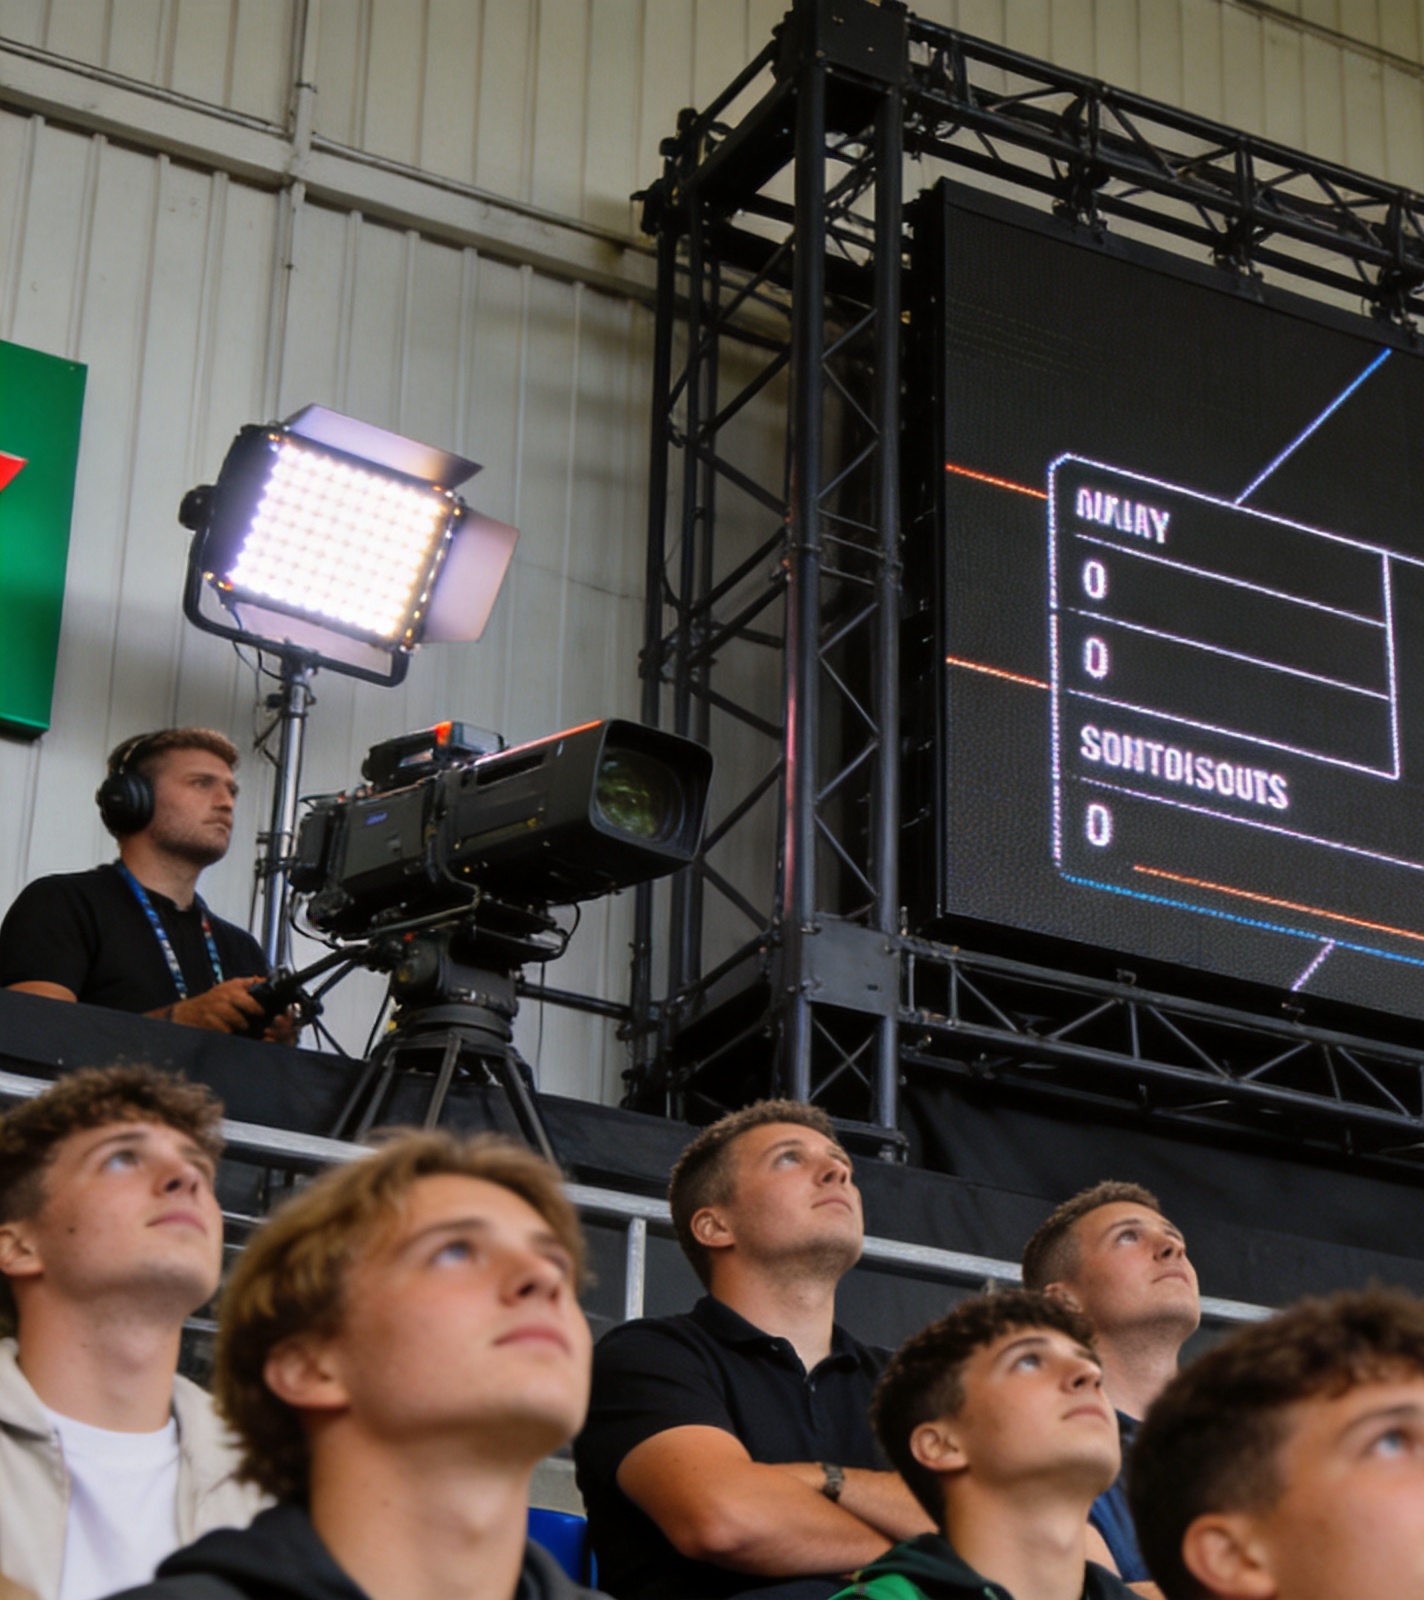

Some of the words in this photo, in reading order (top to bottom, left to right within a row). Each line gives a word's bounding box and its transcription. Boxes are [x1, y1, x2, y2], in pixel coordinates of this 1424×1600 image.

[1082, 559, 1108, 600] 0
[1083, 636, 1109, 679] 0
[1084, 802, 1113, 847] 0
